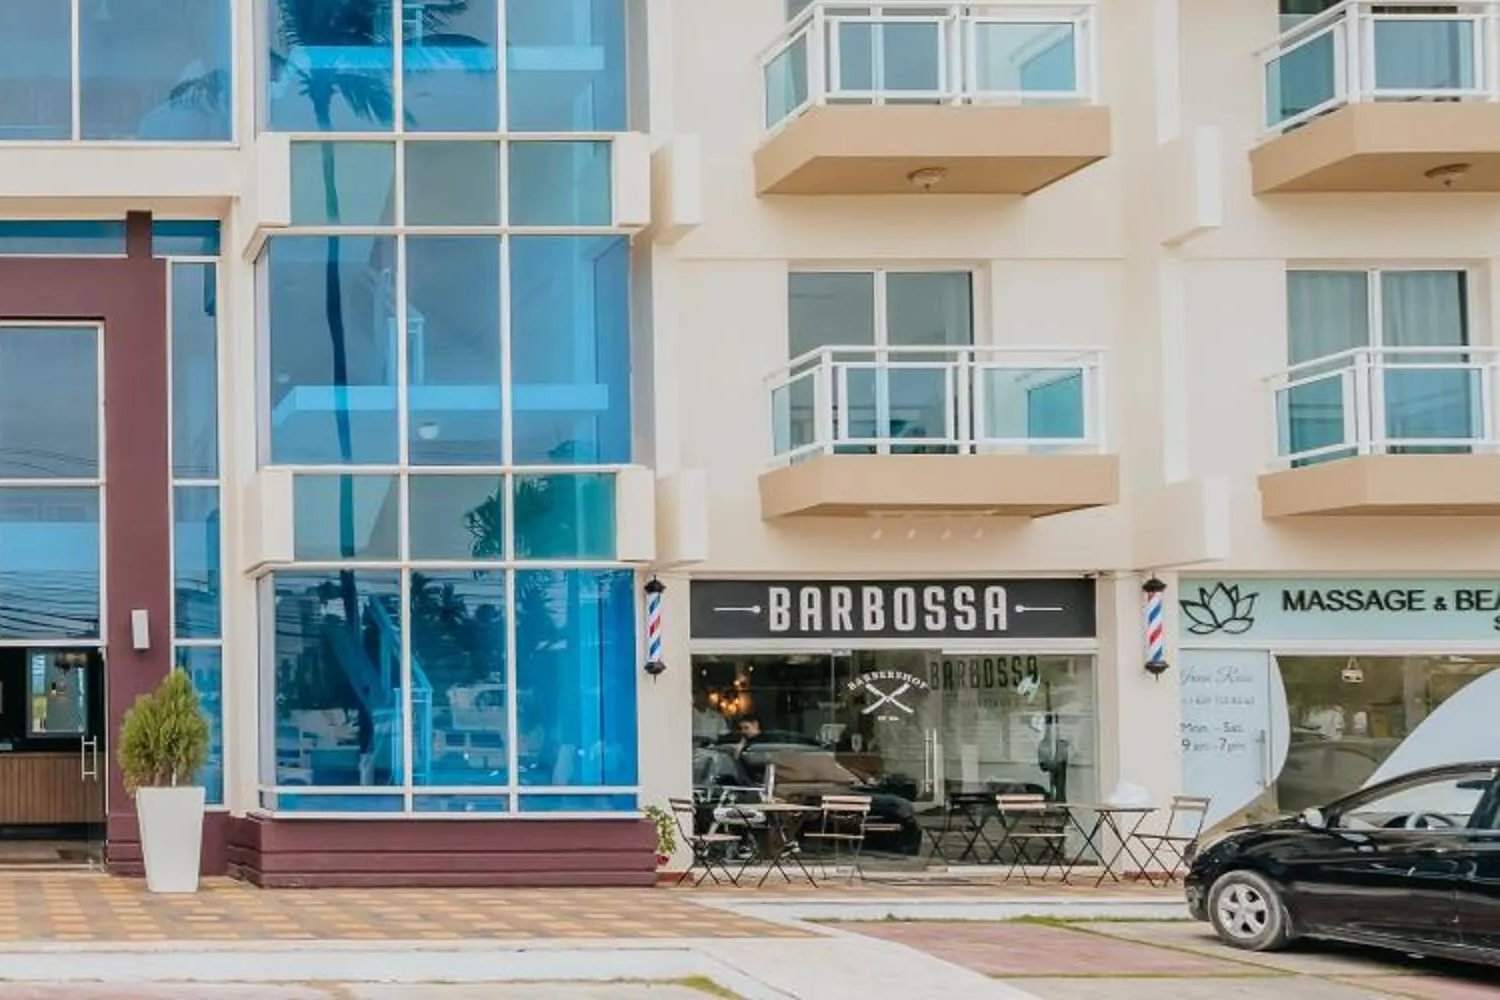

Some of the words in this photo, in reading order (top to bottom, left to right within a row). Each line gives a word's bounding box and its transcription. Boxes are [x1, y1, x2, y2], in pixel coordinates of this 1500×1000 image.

[769, 585, 1007, 631] BARBOSSA
[1282, 589, 1426, 611] MASSAGE
[1433, 596, 1448, 611] &
